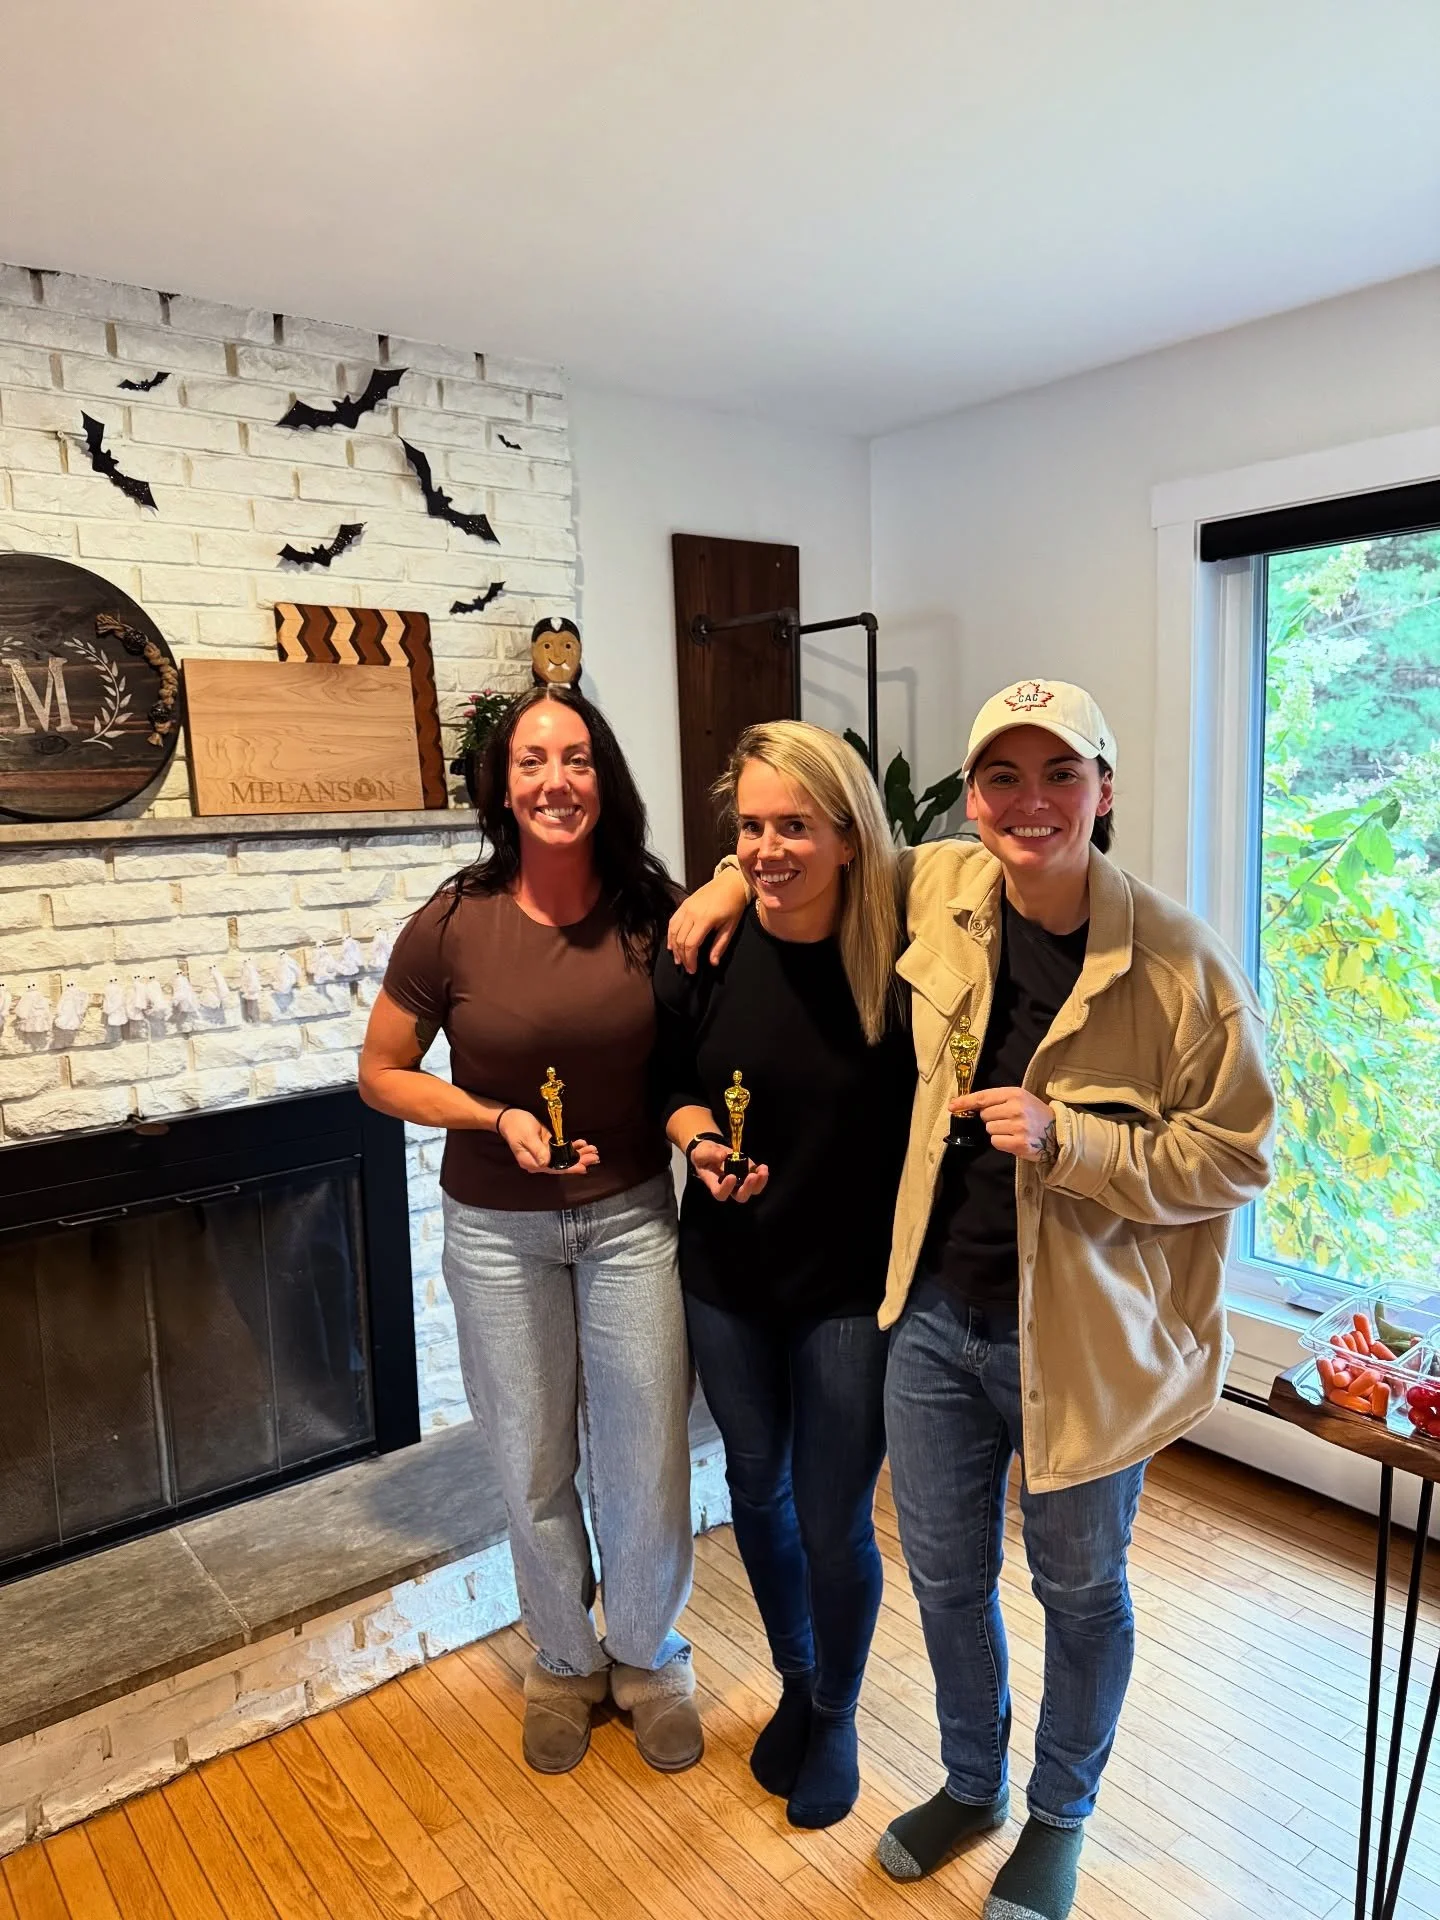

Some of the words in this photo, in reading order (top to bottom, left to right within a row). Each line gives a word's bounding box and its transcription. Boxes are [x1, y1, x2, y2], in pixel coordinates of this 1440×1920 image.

[2, 656, 78, 734] M
[1018, 693, 1039, 703] CAC
[229, 777, 396, 804] MELANSON
